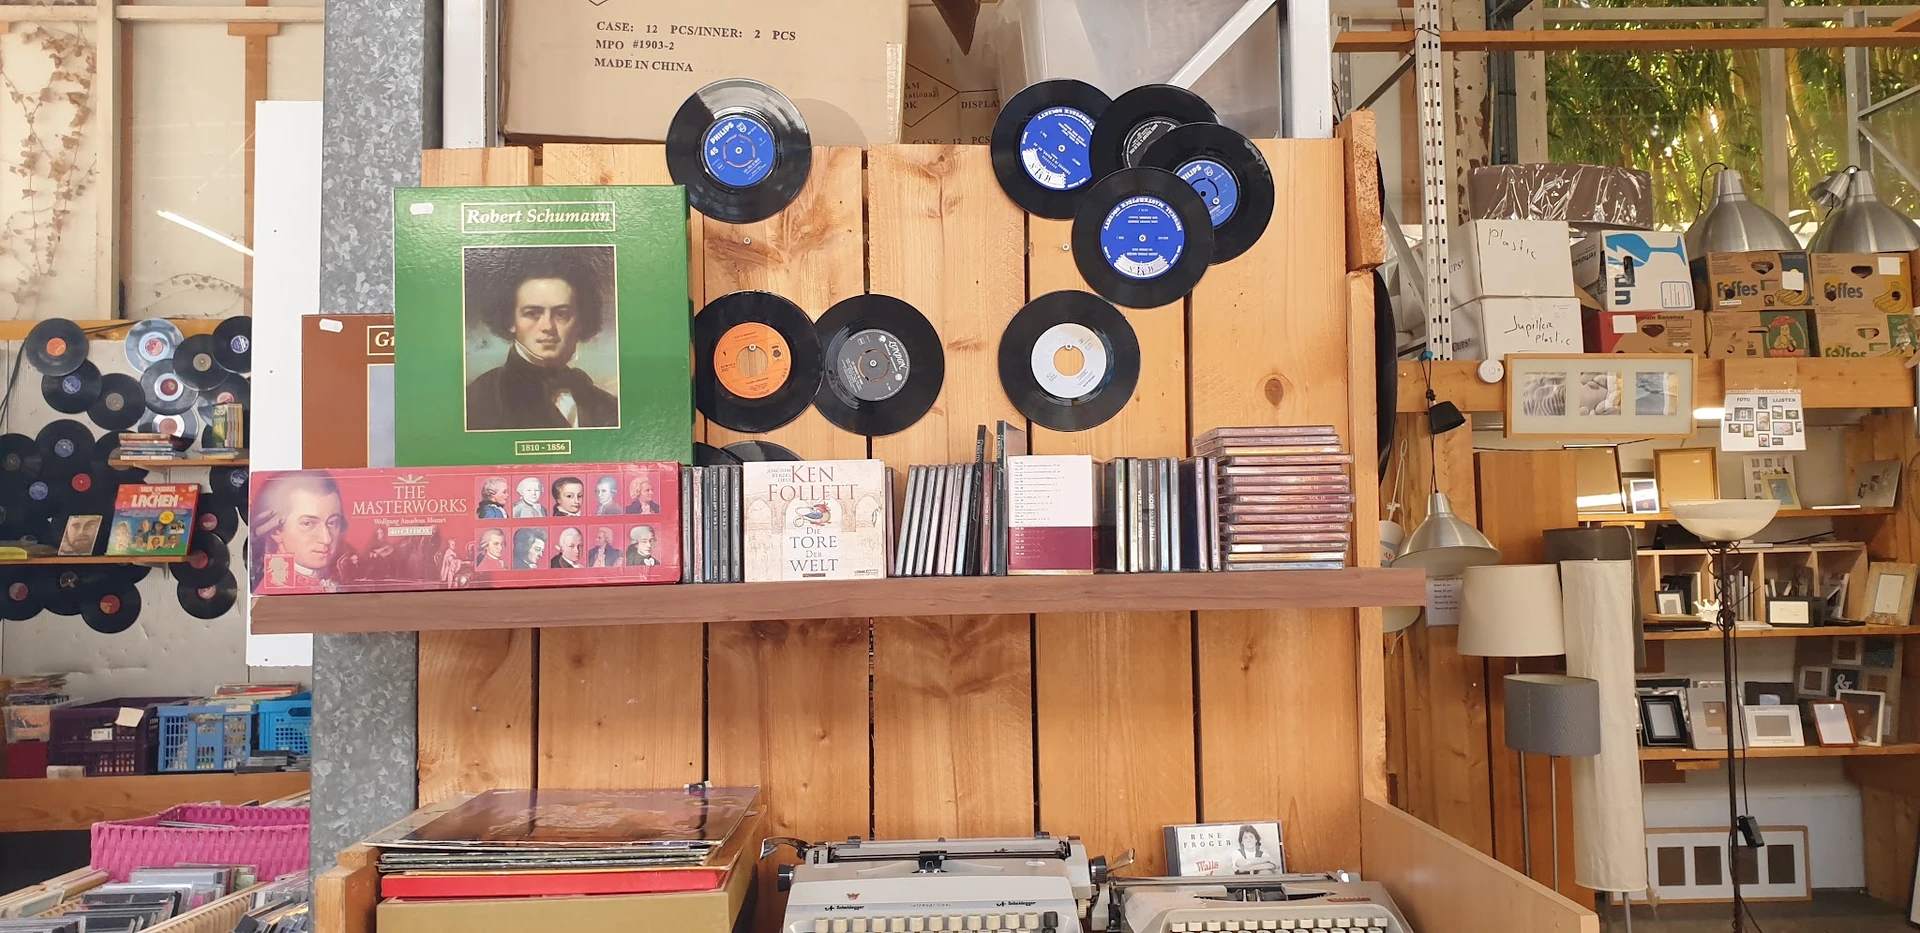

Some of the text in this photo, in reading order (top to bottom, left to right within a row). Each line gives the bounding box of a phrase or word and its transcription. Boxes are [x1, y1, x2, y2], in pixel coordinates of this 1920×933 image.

[596, 21, 796, 41] CASE: 12 PCS/INNER: 2 PCS
[595, 39, 675, 50] MPO #1903-2
[594, 57, 693, 72] MADE IN CHINA
[709, 121, 735, 145] PHILIPS
[709, 146, 719, 156] 45
[1120, 197, 1165, 209] MASTERPIECE
[466, 206, 611, 224] Robert Schumann
[1103, 206, 1121, 231] SOCIETY
[1165, 206, 1182, 231] MUSICAL
[521, 444, 539, 452] 1810
[547, 443, 565, 451] 1856
[791, 465, 834, 483] KEN
[393, 485, 426, 499] THE
[768, 484, 858, 501] FOLLETT
[131, 494, 179, 508] LACHEN
[352, 499, 467, 515] MASTERWORKS
[373, 517, 400, 526] Wolfgang
[789, 536, 837, 549] TORE
[790, 559, 838, 572] WELT
[1183, 839, 1231, 848] FROGER
[1195, 860, 1219, 872] Walls
